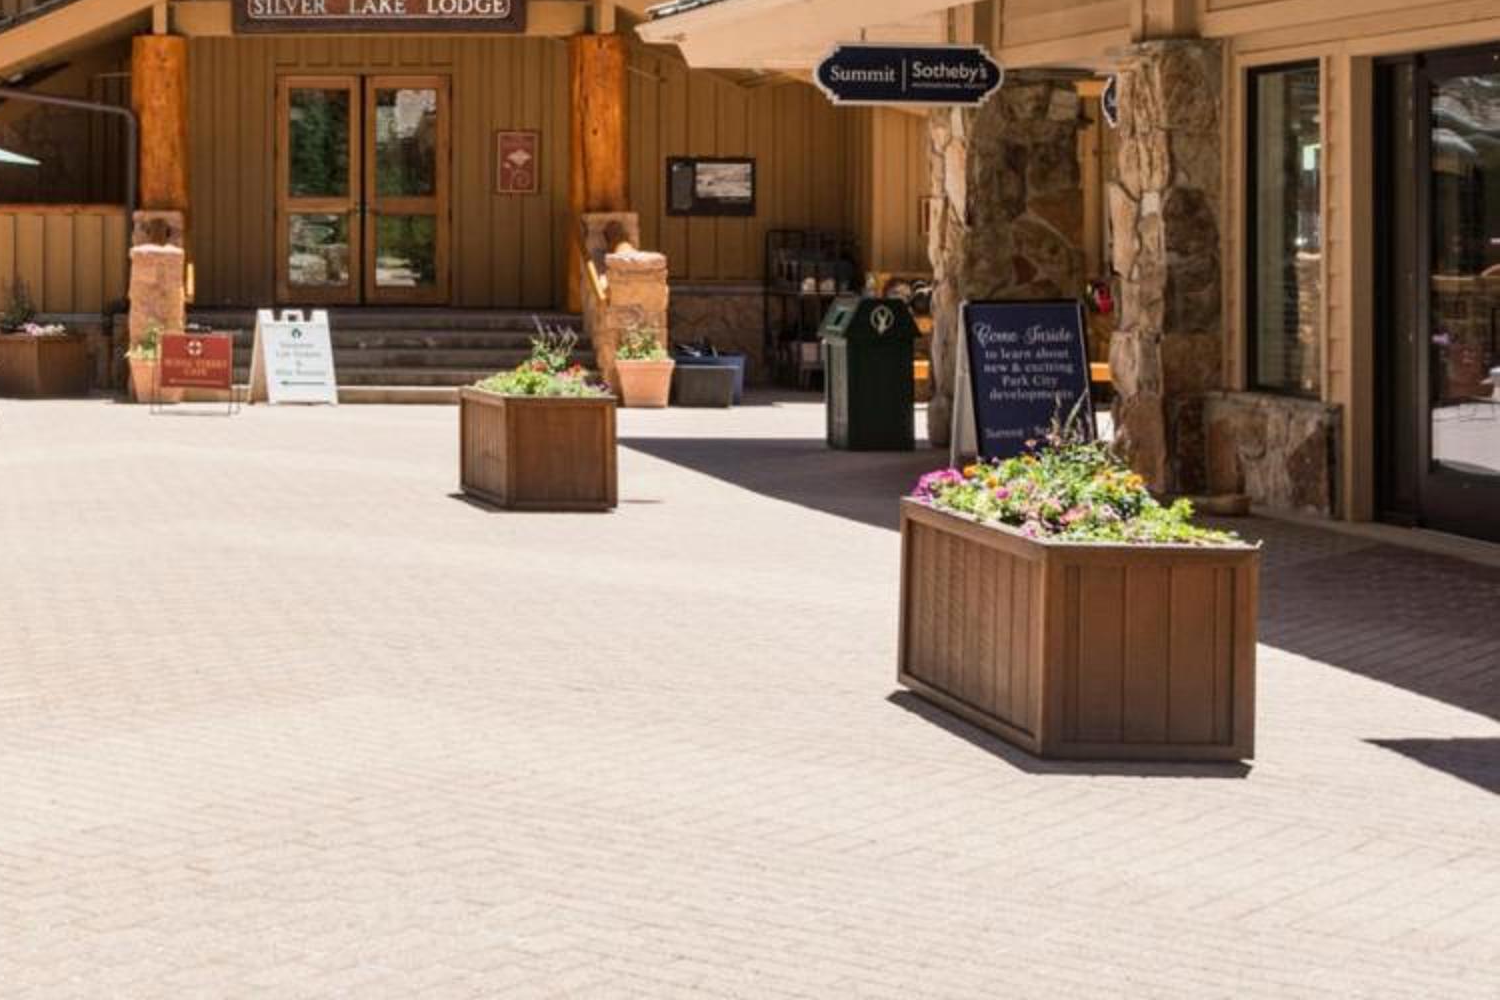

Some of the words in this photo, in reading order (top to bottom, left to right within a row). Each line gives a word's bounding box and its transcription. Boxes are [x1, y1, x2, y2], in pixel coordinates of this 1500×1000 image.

[829, 64, 896, 83] Summit
[911, 61, 988, 83] Sotheby's
[972, 321, 1018, 348] Come
[1023, 324, 1073, 344] Inside
[985, 350, 998, 359] to
[1001, 348, 1031, 360] learn
[1035, 347, 1069, 360] about
[984, 363, 1008, 373] new
[1025, 362, 1074, 374] exciting
[1002, 375, 1030, 386] Park
[1032, 375, 1060, 388] City
[989, 387, 1074, 402] developments
